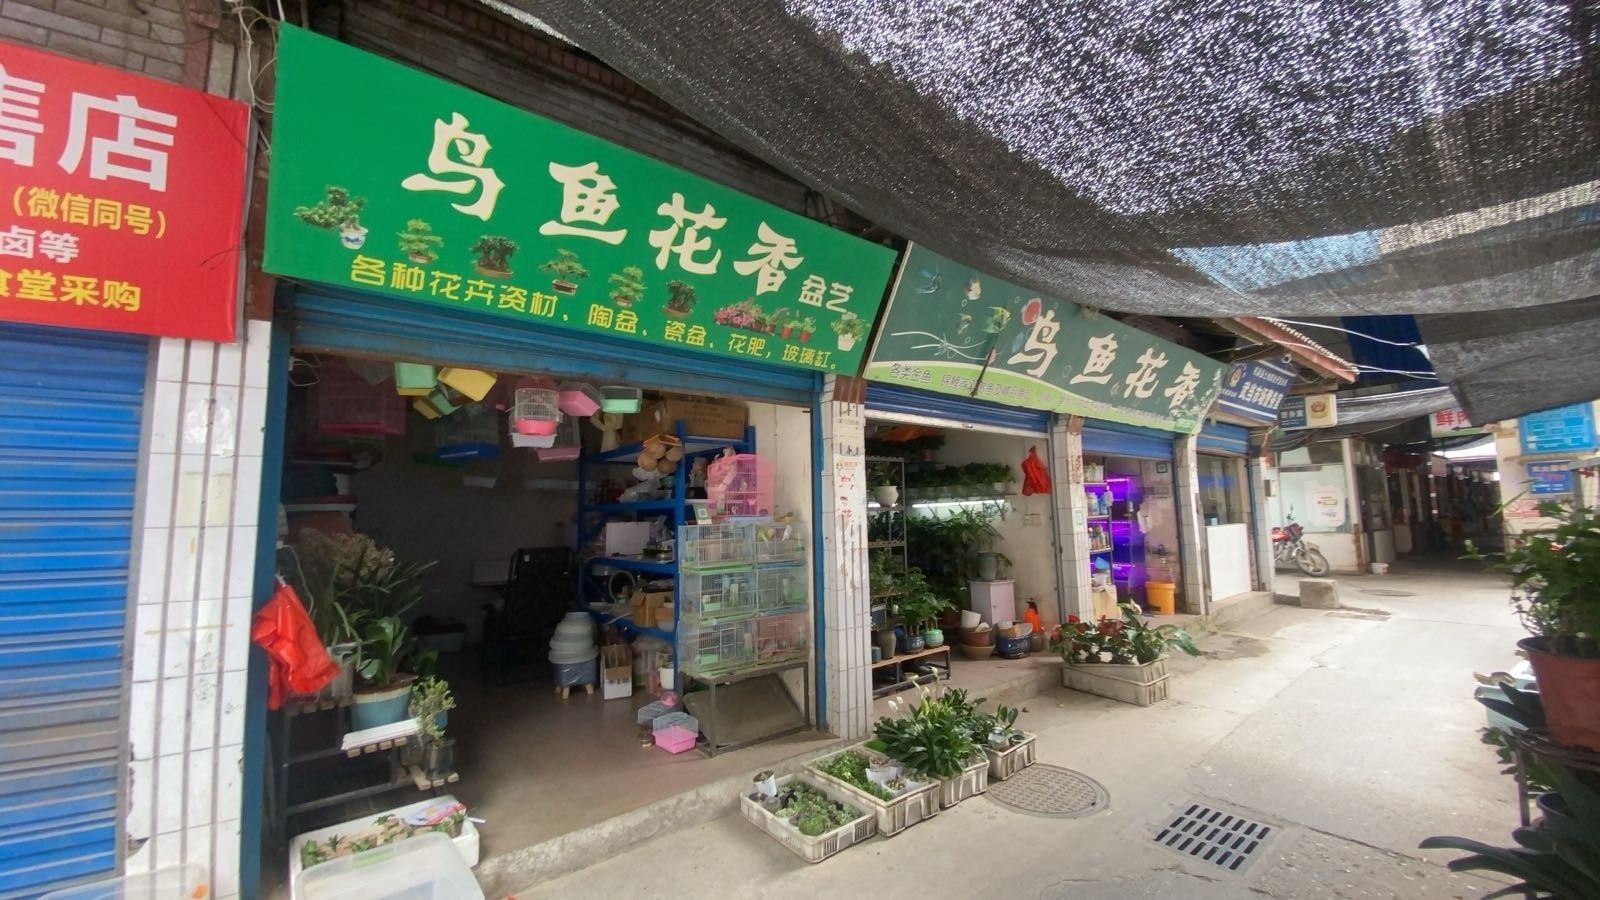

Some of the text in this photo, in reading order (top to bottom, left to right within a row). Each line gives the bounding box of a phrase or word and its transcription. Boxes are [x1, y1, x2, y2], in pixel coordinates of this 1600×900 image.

[401, 112, 804, 296] 鸟鱼花香
[799, 274, 854, 314] 盆艺
[1007, 309, 1201, 410] 鸟鱼花香
